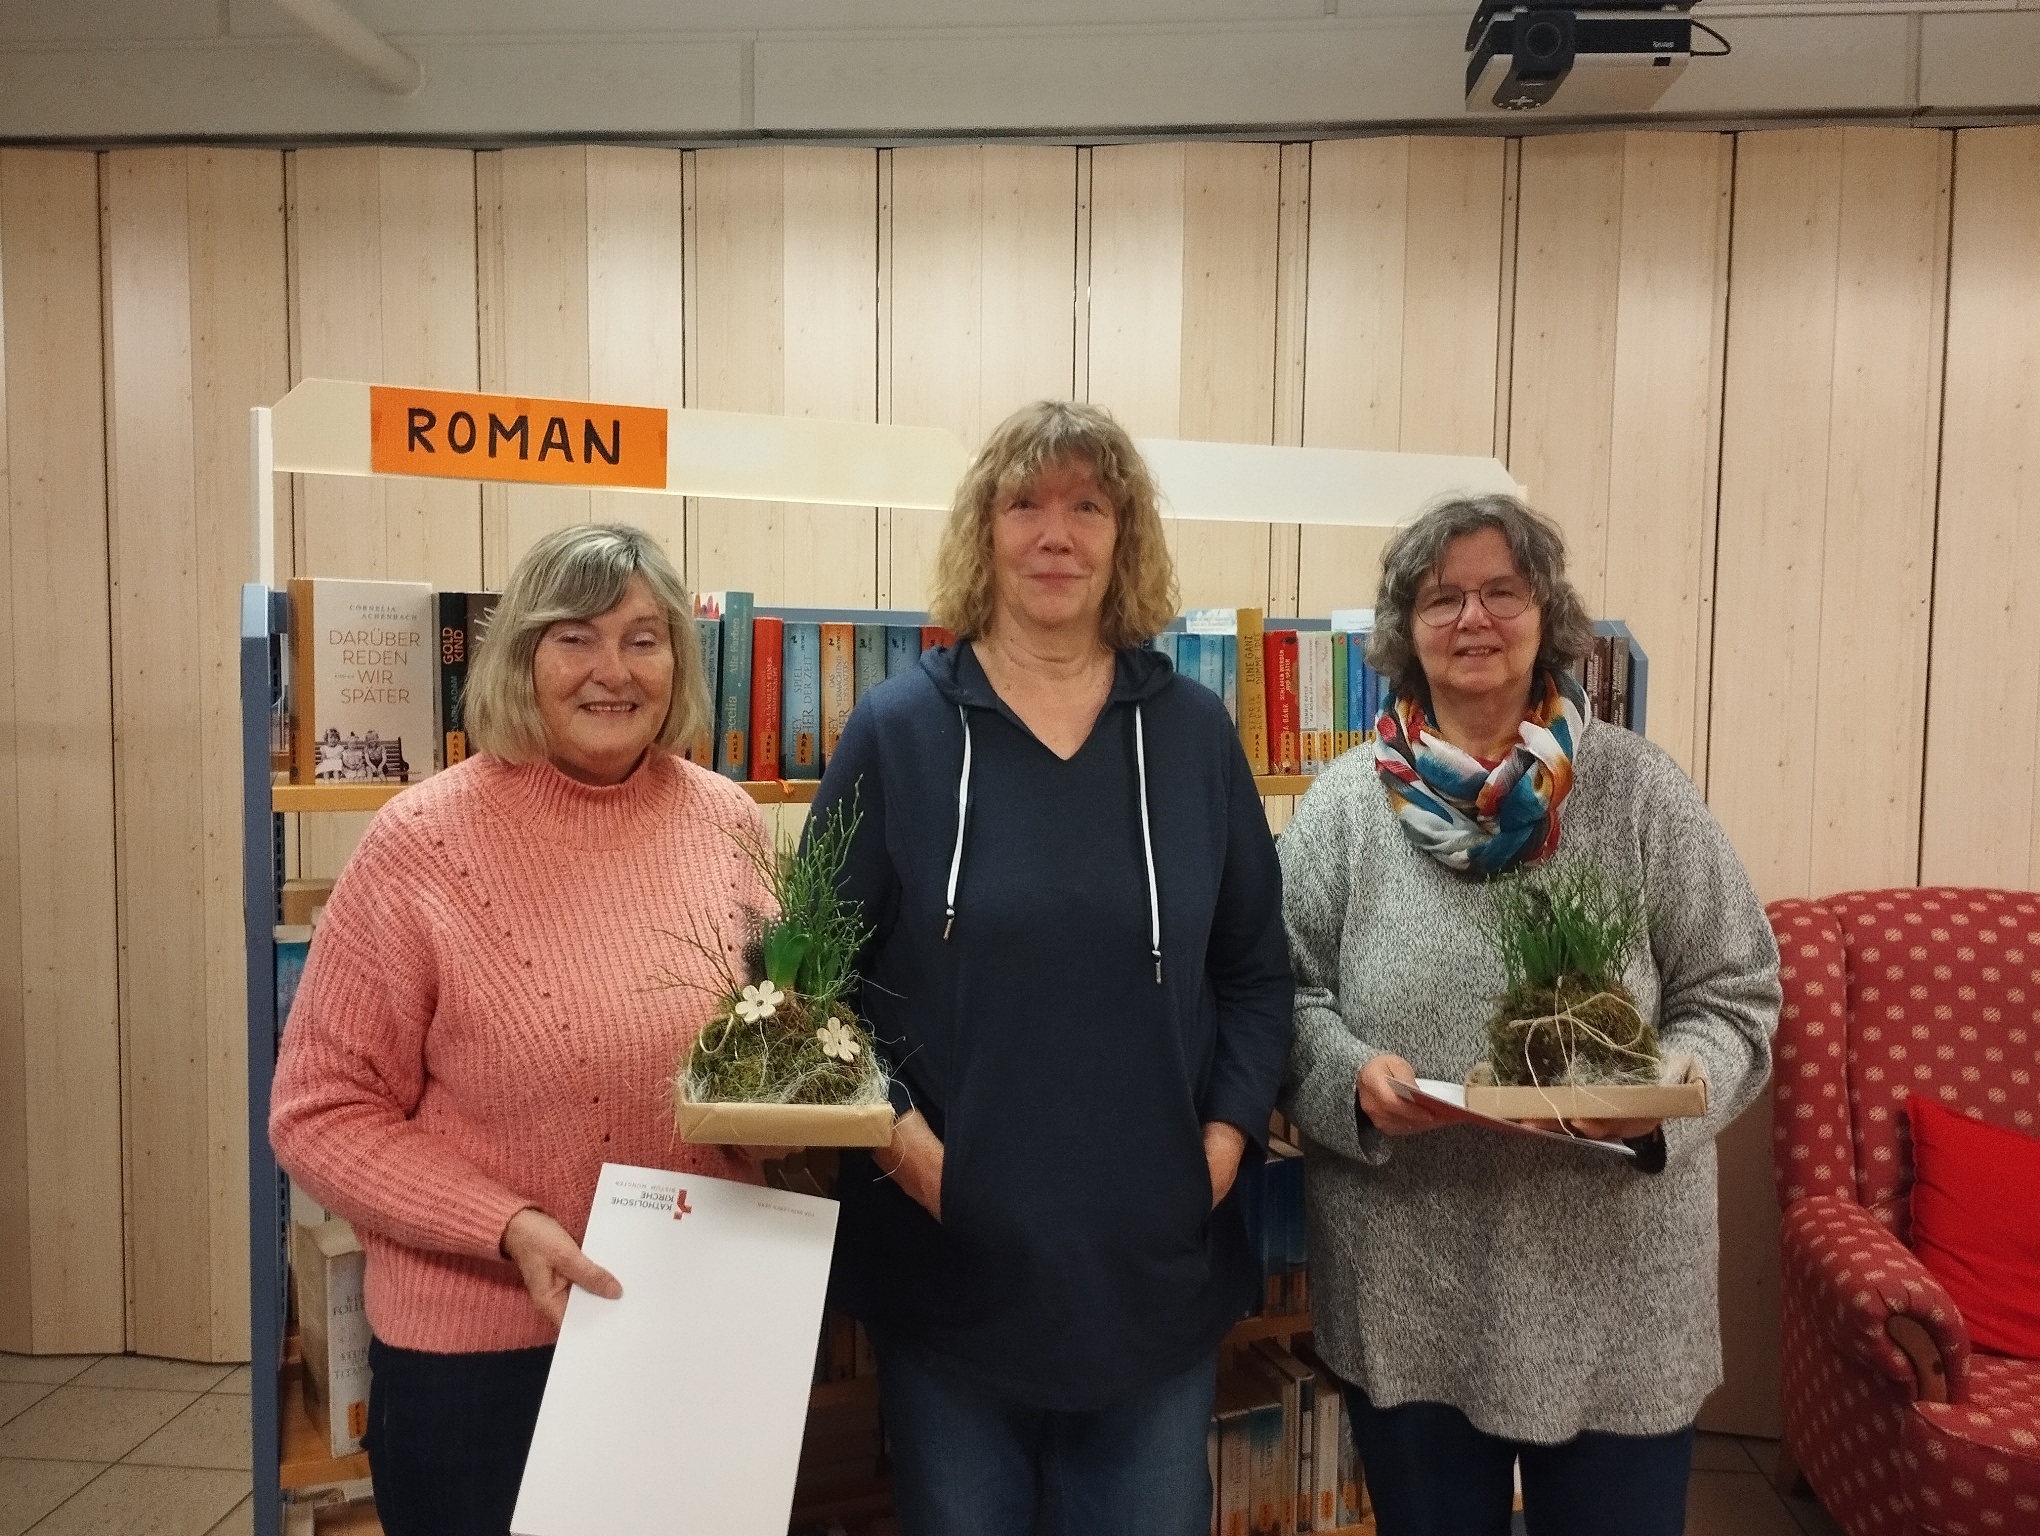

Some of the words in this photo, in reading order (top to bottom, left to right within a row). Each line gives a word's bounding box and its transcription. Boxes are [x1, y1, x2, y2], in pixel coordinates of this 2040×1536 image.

[407, 407, 620, 466] ROMAN
[349, 604, 396, 612] CORNELIA
[361, 613, 418, 621] ACHENBACH
[329, 628, 421, 647] DARÜBER
[442, 626, 454, 665] GOLD
[453, 628, 464, 663] KIND
[1244, 635, 1254, 659] GANZ
[343, 650, 407, 666] REDEN
[803, 654, 812, 678] ZEIT
[357, 669, 393, 685] WIR
[793, 666, 803, 693] SPIEL
[1246, 660, 1255, 683] EINE
[1255, 655, 1263, 685] DUMME
[341, 686, 410, 704] SPÄTER
[803, 682, 813, 704] DER
[614, 1180, 649, 1190] MÜNSTER
[650, 1184, 676, 1193] BISTUM
[610, 1196, 673, 1212] KATHOLISCHE
[639, 1190, 674, 1203] KIRCHE
